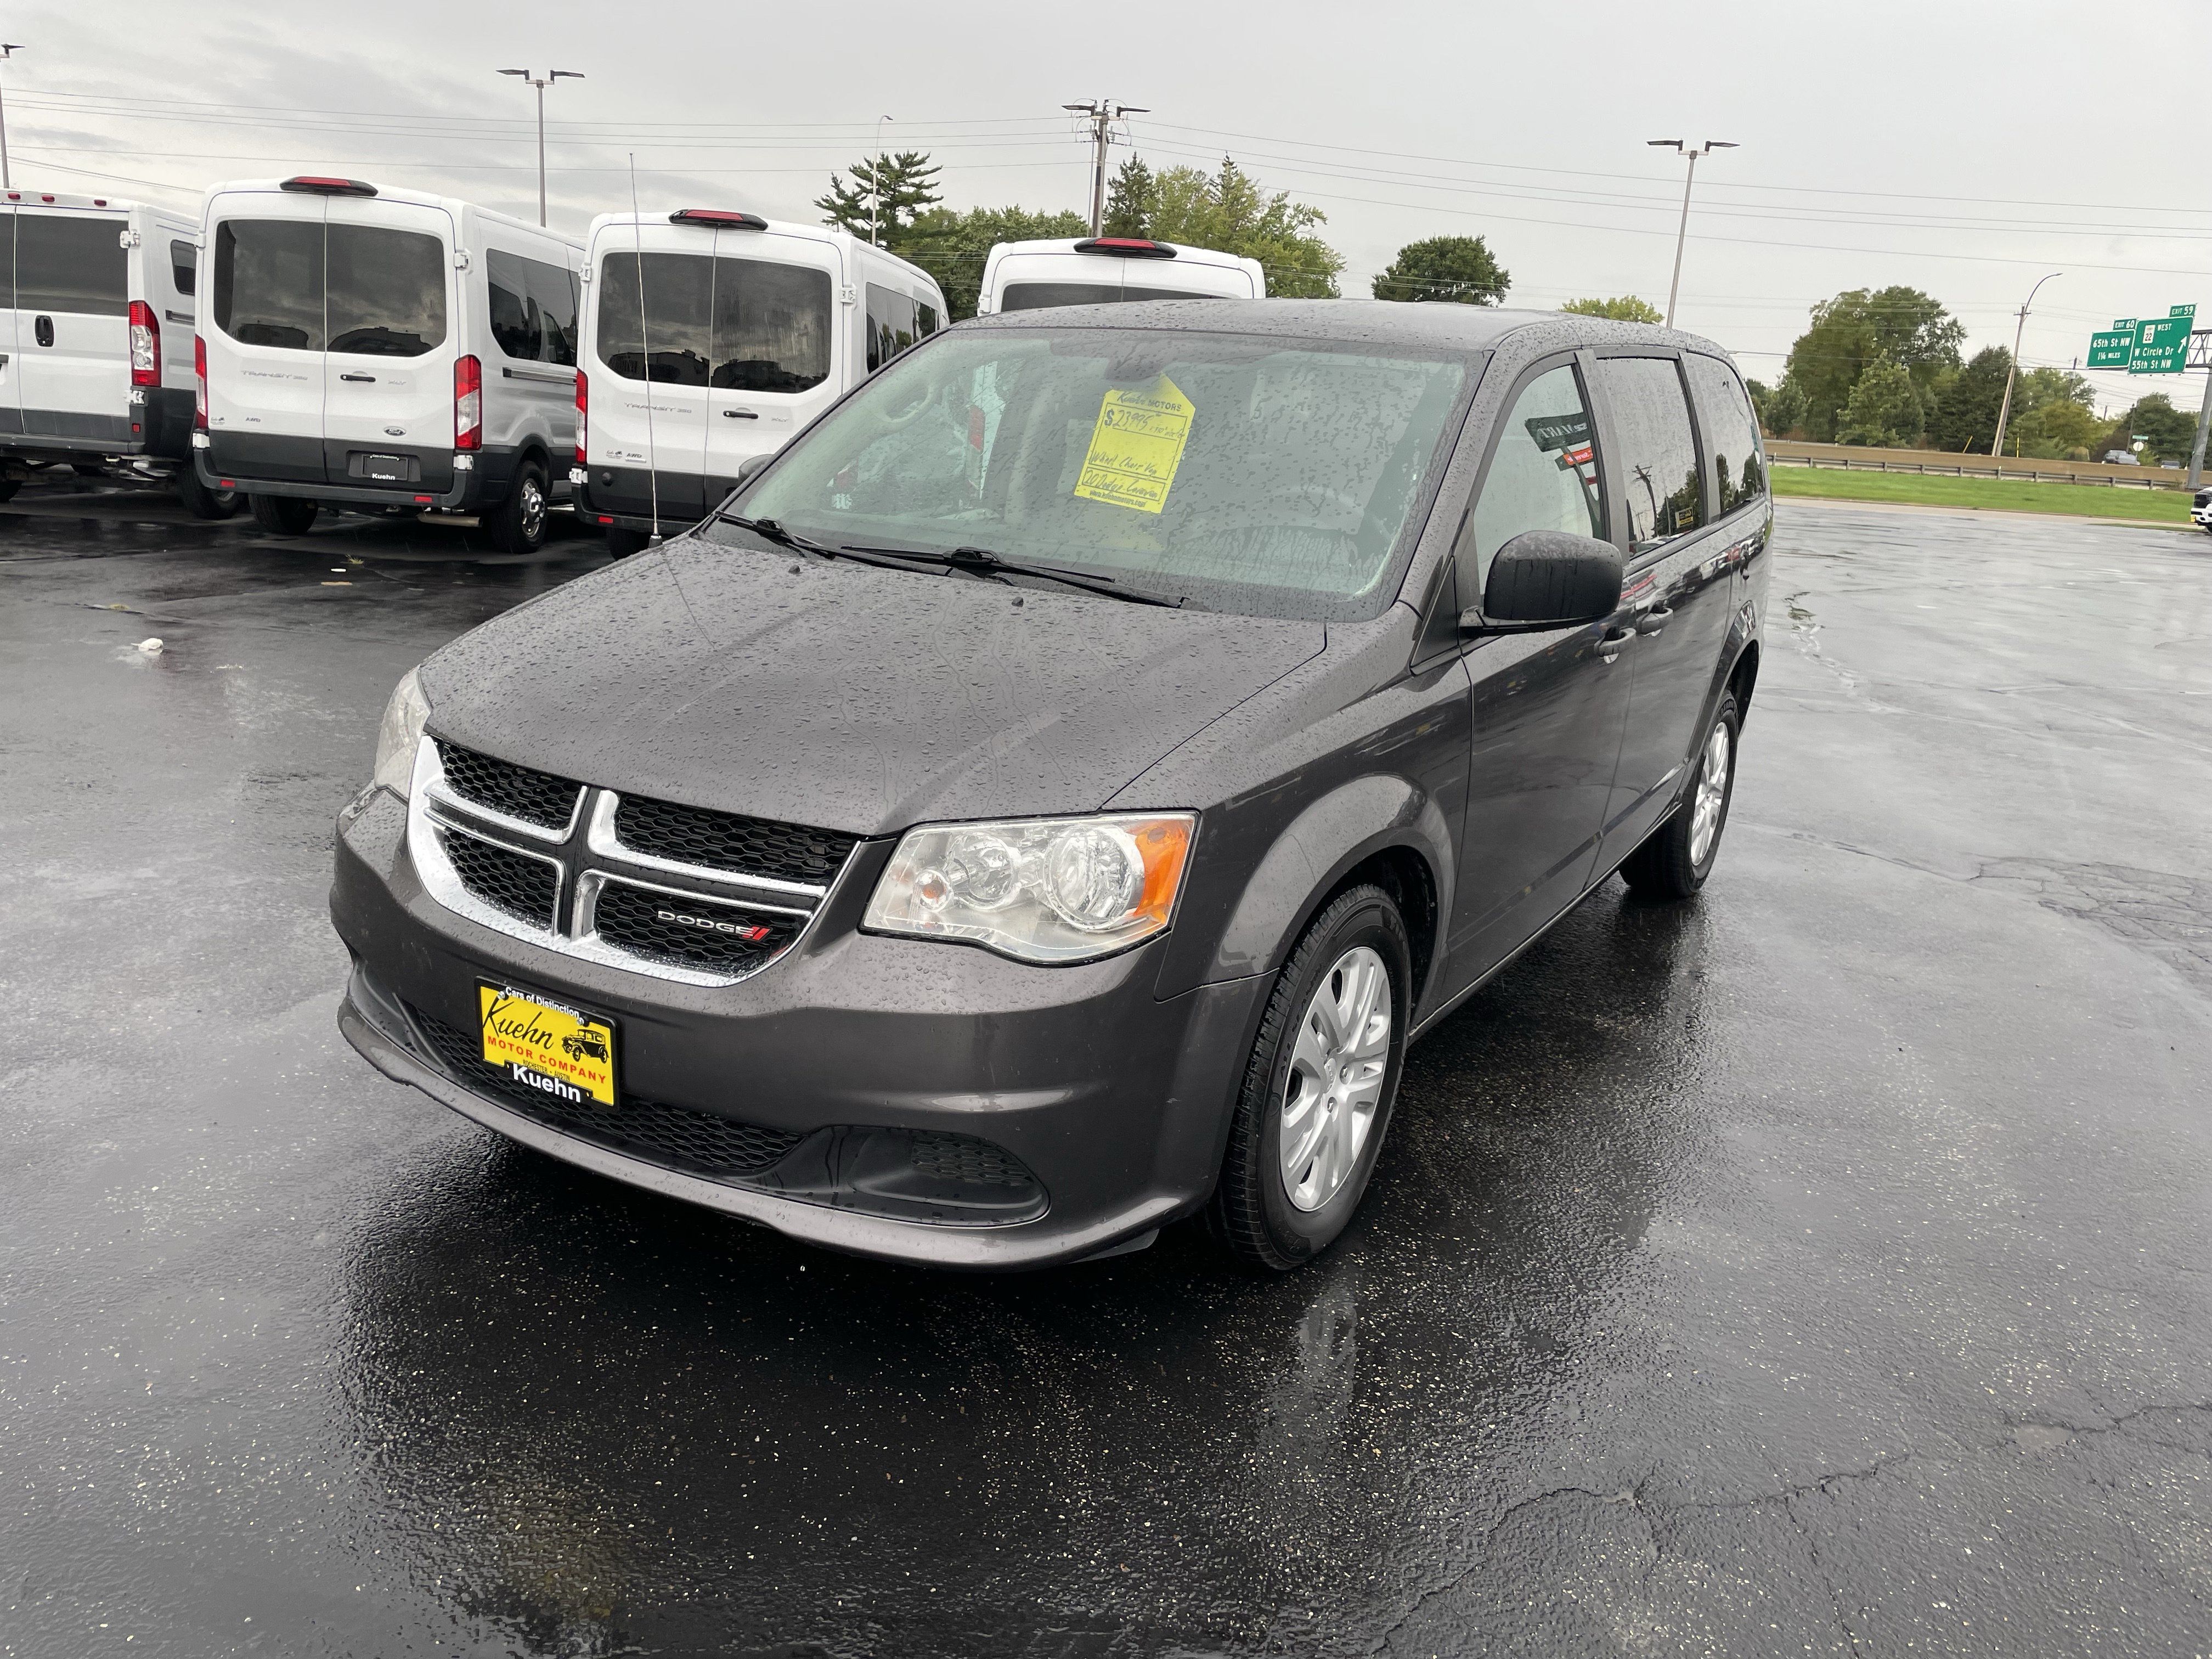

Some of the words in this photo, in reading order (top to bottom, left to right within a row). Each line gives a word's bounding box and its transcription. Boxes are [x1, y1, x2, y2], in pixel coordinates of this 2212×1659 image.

[2183, 306, 2193, 315] 59
[2126, 320, 2135, 329] 60
[2157, 323, 2172, 331] WEST
[2145, 332, 2152, 341] 22
[2093, 338, 2108, 348] 65th
[2111, 338, 2118, 347] St
[2120, 337, 2131, 346] NW
[2134, 348, 2140, 357] W
[2142, 347, 2163, 356] Circle
[2165, 346, 2174, 356] Dr
[2131, 360, 2148, 370] 55th
[2150, 359, 2158, 369] St
[2160, 359, 2172, 369] NW
[241, 370, 292, 379] TRANSIT
[624, 402, 676, 411] TRANSIT
[1148, 399, 1182, 411] MOTORS
[658, 910, 754, 936] DODGE
[505, 986, 524, 1000] Cars
[526, 994, 535, 1003] of
[536, 996, 580, 1019] Distinction
[483, 994, 555, 1050] Kuehn
[488, 1035, 533, 1059] MOTOR
[539, 1053, 606, 1084] COMPANY
[523, 1059, 548, 1074] ROCHESTER
[554, 1070, 571, 1082] AUSTIN
[512, 1063, 581, 1103] Kuehn
